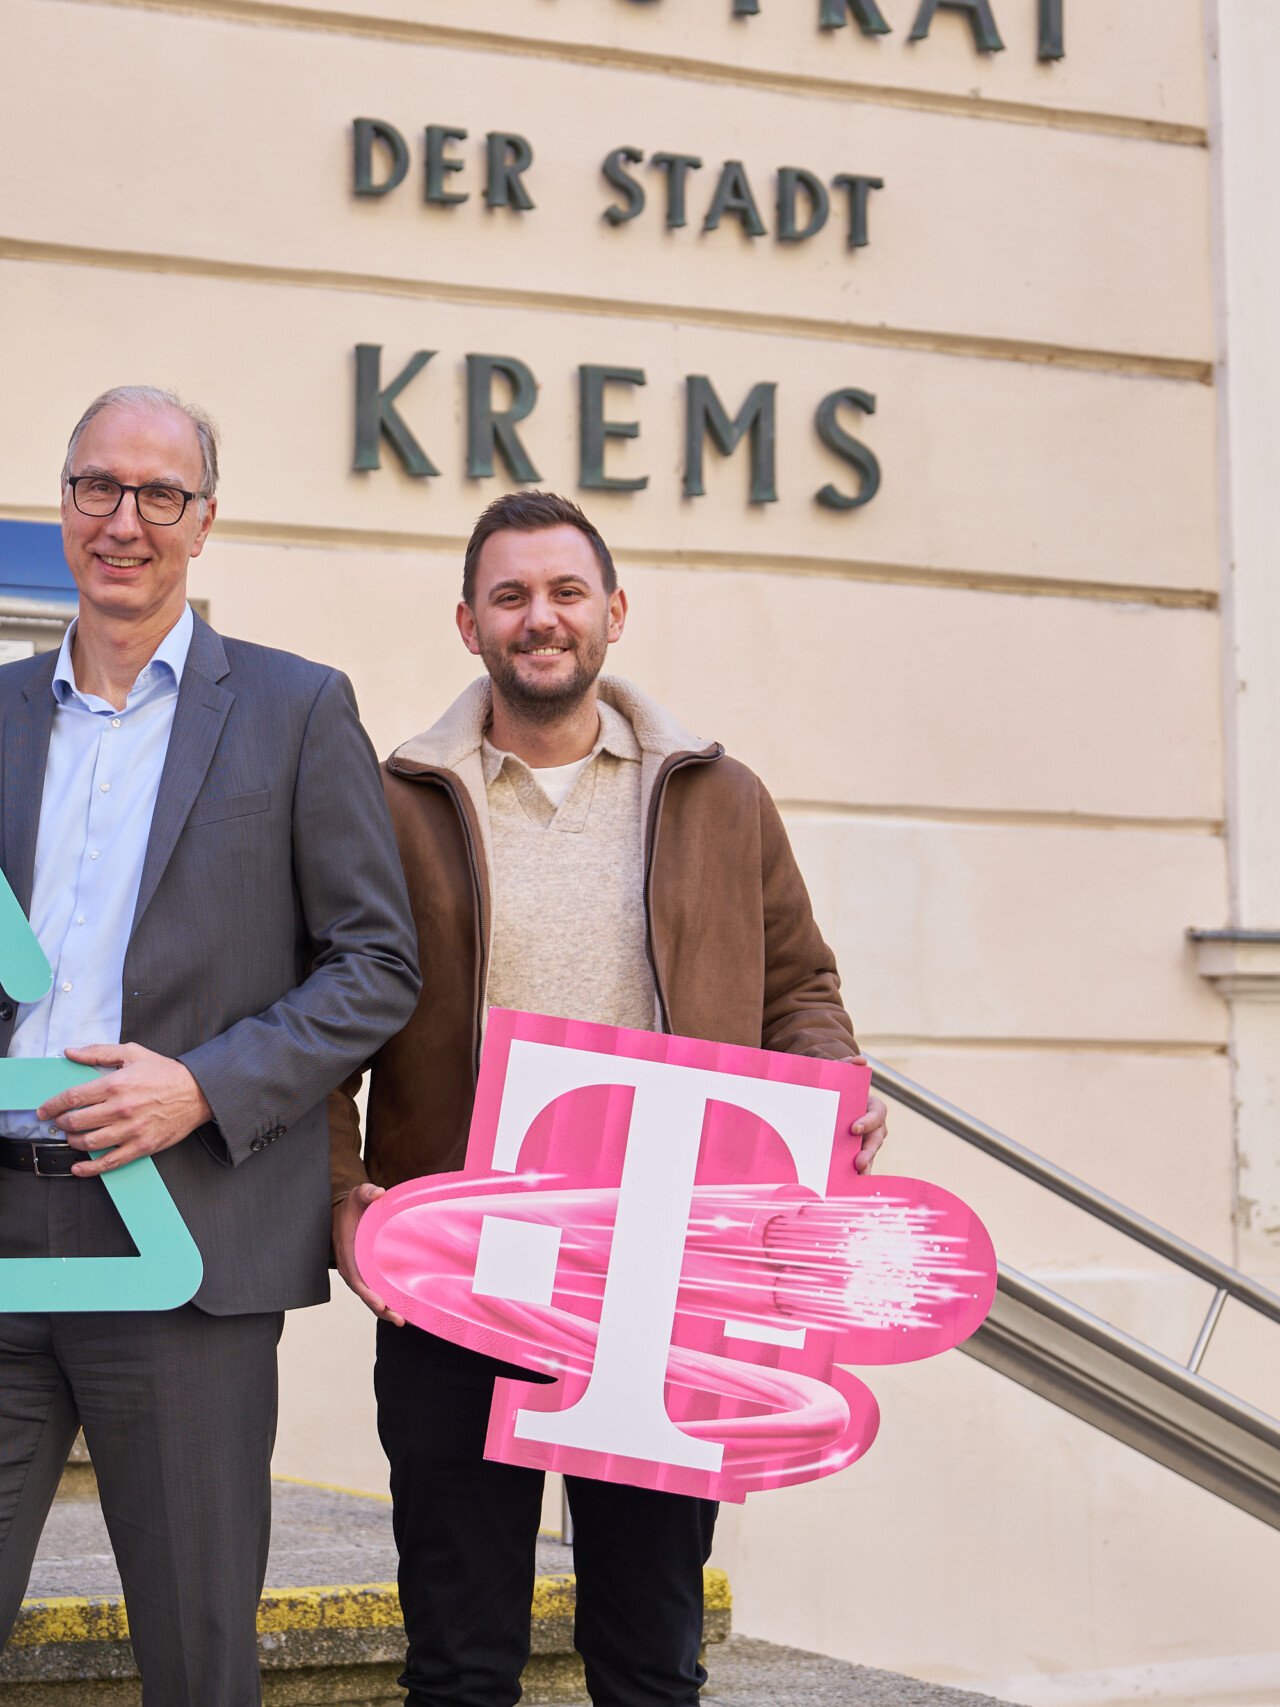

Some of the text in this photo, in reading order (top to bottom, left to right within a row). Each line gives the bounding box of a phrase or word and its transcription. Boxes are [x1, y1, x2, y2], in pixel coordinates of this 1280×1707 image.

[352, 118, 884, 248] DER STADT
[352, 343, 883, 511] KREMS
[491, 1038, 841, 1473] T
